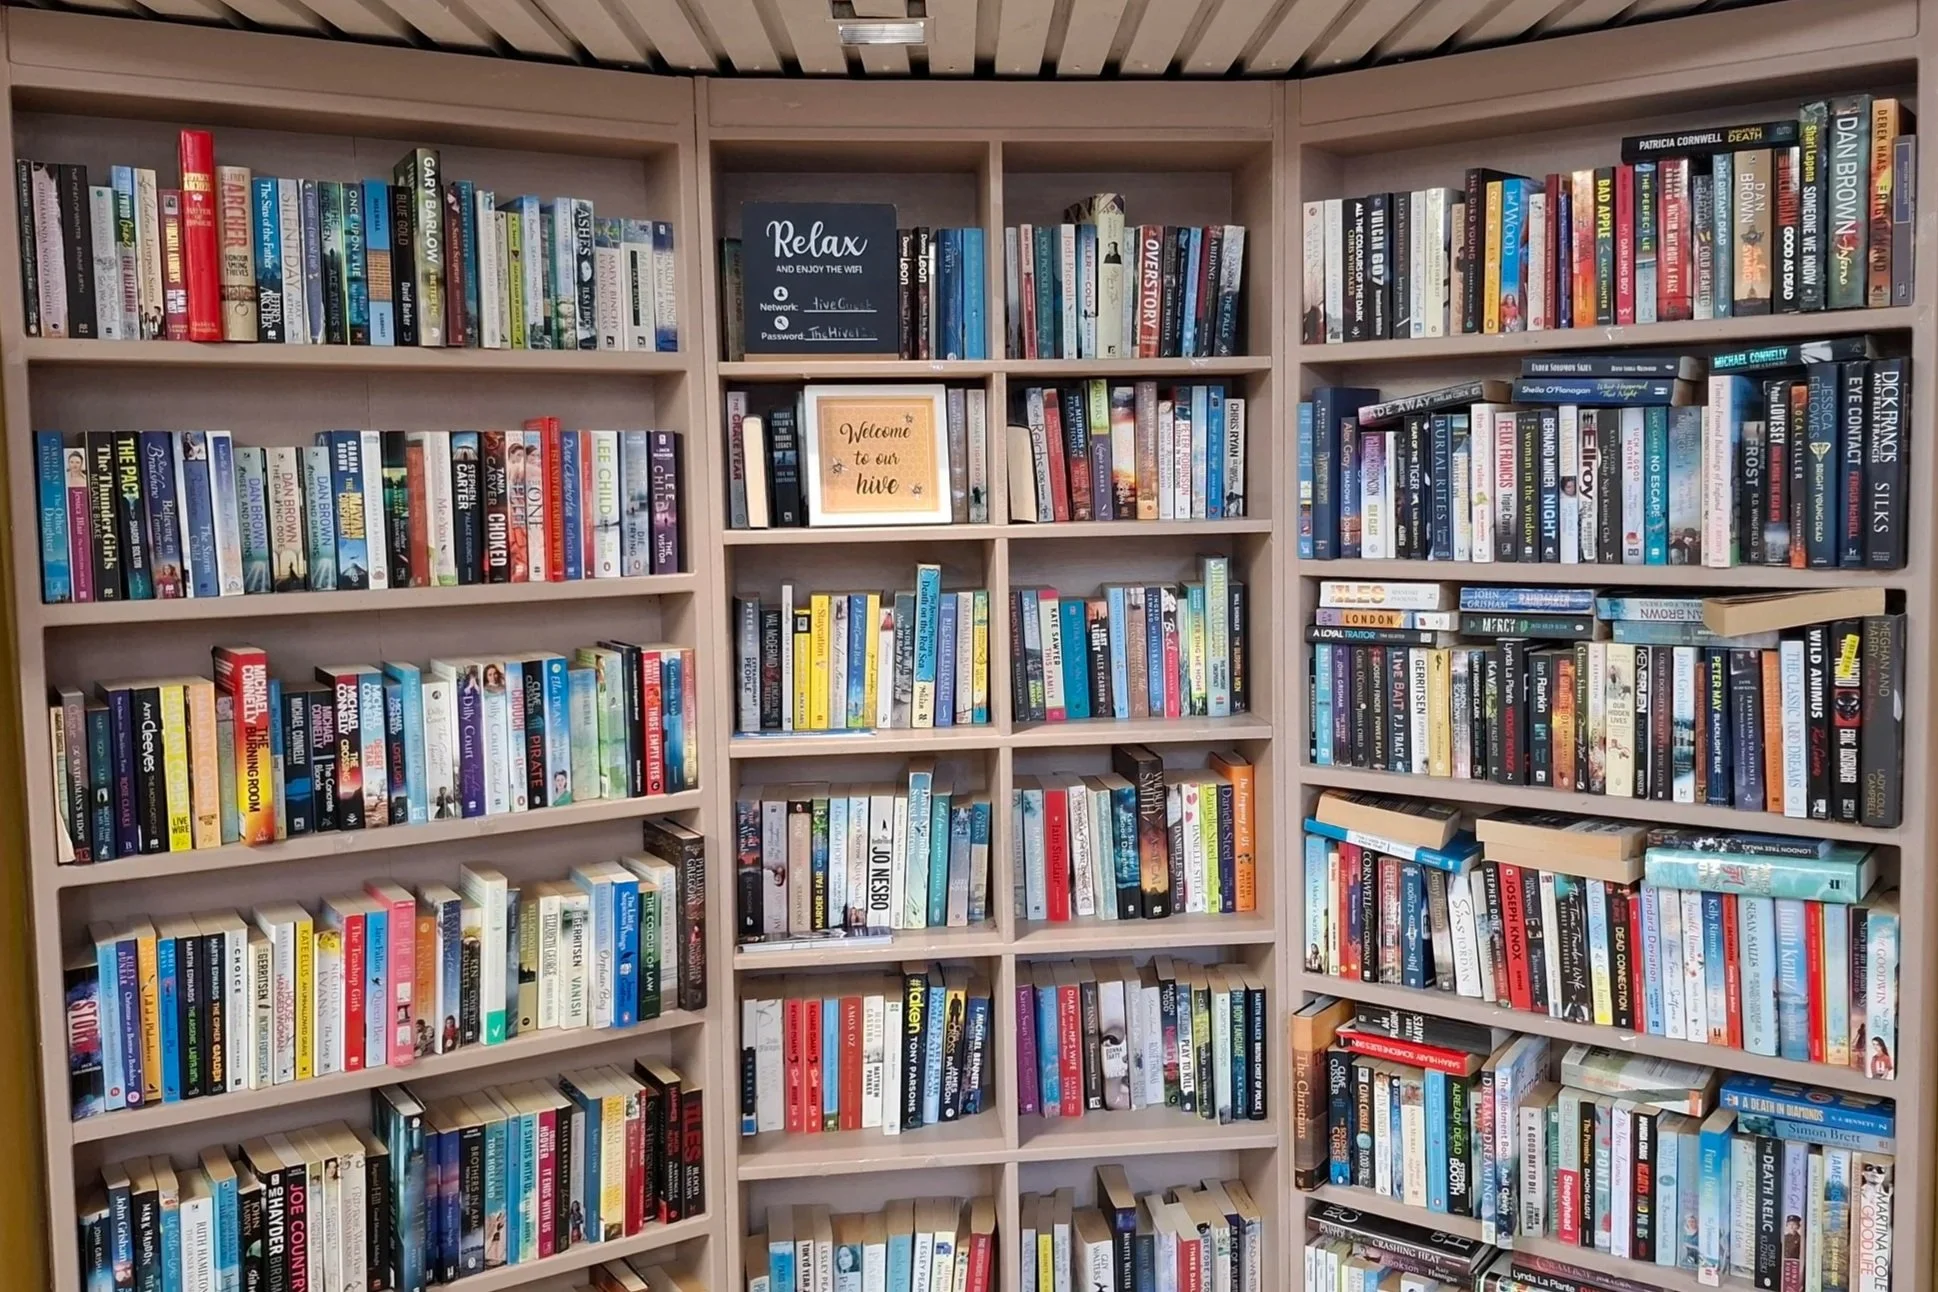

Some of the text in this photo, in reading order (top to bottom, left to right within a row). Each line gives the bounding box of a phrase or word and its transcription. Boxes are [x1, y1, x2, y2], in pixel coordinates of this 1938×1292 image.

[1639, 133, 1723, 150] PATRICIA CORNWELL
[261, 182, 271, 198] The
[1835, 117, 1859, 235] DAN BROWN
[262, 200, 272, 217] Sins
[349, 191, 358, 218] ONCE
[396, 194, 408, 245] BLUE GOLD
[424, 157, 438, 263] GARY BARLOW
[1356, 203, 1364, 218] ALL
[1598, 179, 1613, 239] BAD APPLE
[263, 228, 273, 241] the
[264, 244, 273, 268] Father
[351, 223, 359, 249] UPON
[578, 209, 591, 256] ASHES
[766, 220, 868, 258] Relax
[1371, 210, 1384, 286] VULCAN 607
[1803, 186, 1817, 285] SOMEONE WE KNOW
[352, 263, 361, 277] LIE
[777, 265, 862, 273] AND ENJOY THE WIFI
[900, 258, 911, 285] Leon
[918, 255, 929, 283] Leon
[1143, 239, 1159, 329] OVERSTORY
[1356, 272, 1363, 283] OF
[1783, 227, 1794, 300] GOOD AS DEAD
[401, 283, 412, 326] David Barker
[840, 421, 910, 444] Welcome
[1229, 403, 1239, 457] CHRIS RYAN
[1847, 377, 1863, 465] EYE CONTACT
[1880, 371, 1899, 462] DICK FRANCIS
[118, 438, 139, 500] THE PACT
[337, 443, 348, 471] BROWN
[347, 441, 359, 473] GRAHAM
[853, 450, 900, 465] to our
[1031, 424, 1047, 467] Reichs
[1499, 421, 1513, 488] FELIX FRANCIS
[1580, 430, 1597, 501] Ellroy
[457, 464, 468, 510] CARTER
[597, 438, 612, 514] LEE CHILD
[857, 473, 899, 494] hive
[1543, 418, 1555, 539] BERNARD MINIER NIGHT
[1650, 455, 1660, 517] NO ESCAPE
[97, 444, 116, 569] The Thunder Girls
[282, 473, 297, 543] DAN BROWN
[1874, 482, 1890, 533] SILKS
[489, 513, 506, 567] CHOKED
[766, 613, 780, 668] VAL McDERMID
[918, 581, 930, 668] Death on the Red Sea
[1345, 614, 1394, 625] LONDON
[1483, 618, 1515, 633] MERCY
[243, 665, 257, 725] CONNELLY
[254, 665, 266, 716] MICHAEL
[1097, 672, 1105, 703] SCARROW
[1414, 659, 1426, 715] GERRITSEN
[1501, 643, 1515, 704] Lynda La Plante
[1537, 662, 1548, 713] Ian Rankin
[1712, 656, 1722, 711] PETER MAY
[1810, 630, 1823, 718] WILD ANIMUS
[141, 703, 157, 772] Ann Cleeves
[257, 727, 268, 749] THE
[530, 735, 543, 788] PIRATE
[1394, 732, 1405, 758] TRACY
[245, 727, 260, 813] BURNING ROOM
[871, 847, 890, 911] JO NESBO
[1362, 852, 1373, 908] CORNWELL
[572, 917, 582, 967] GERRITSEN
[645, 896, 655, 991] THE COLOUR OF LAW
[1505, 879, 1522, 960] JOSEPH KNOX
[348, 923, 361, 1012] The Teashop Girls
[1615, 927, 1628, 1011] DEAD CONNECTION
[571, 976, 582, 1017] VANISH
[908, 979, 925, 1112] #taken TONY PARSONS
[1297, 1054, 1310, 1138] The Christians
[1452, 1082, 1462, 1154] ALREADY DEAD
[1788, 1122, 1861, 1143] Simon Brett
[1562, 1175, 1573, 1230] Sleepyhead
[1762, 1155, 1774, 1231] DEATH RELIC
[115, 1196, 128, 1262] John Grisham
[268, 1198, 283, 1256] HAYDER
[289, 1184, 306, 1292] JOE COUNTRY
[1874, 1192, 1887, 1291] MARTINA COLE
